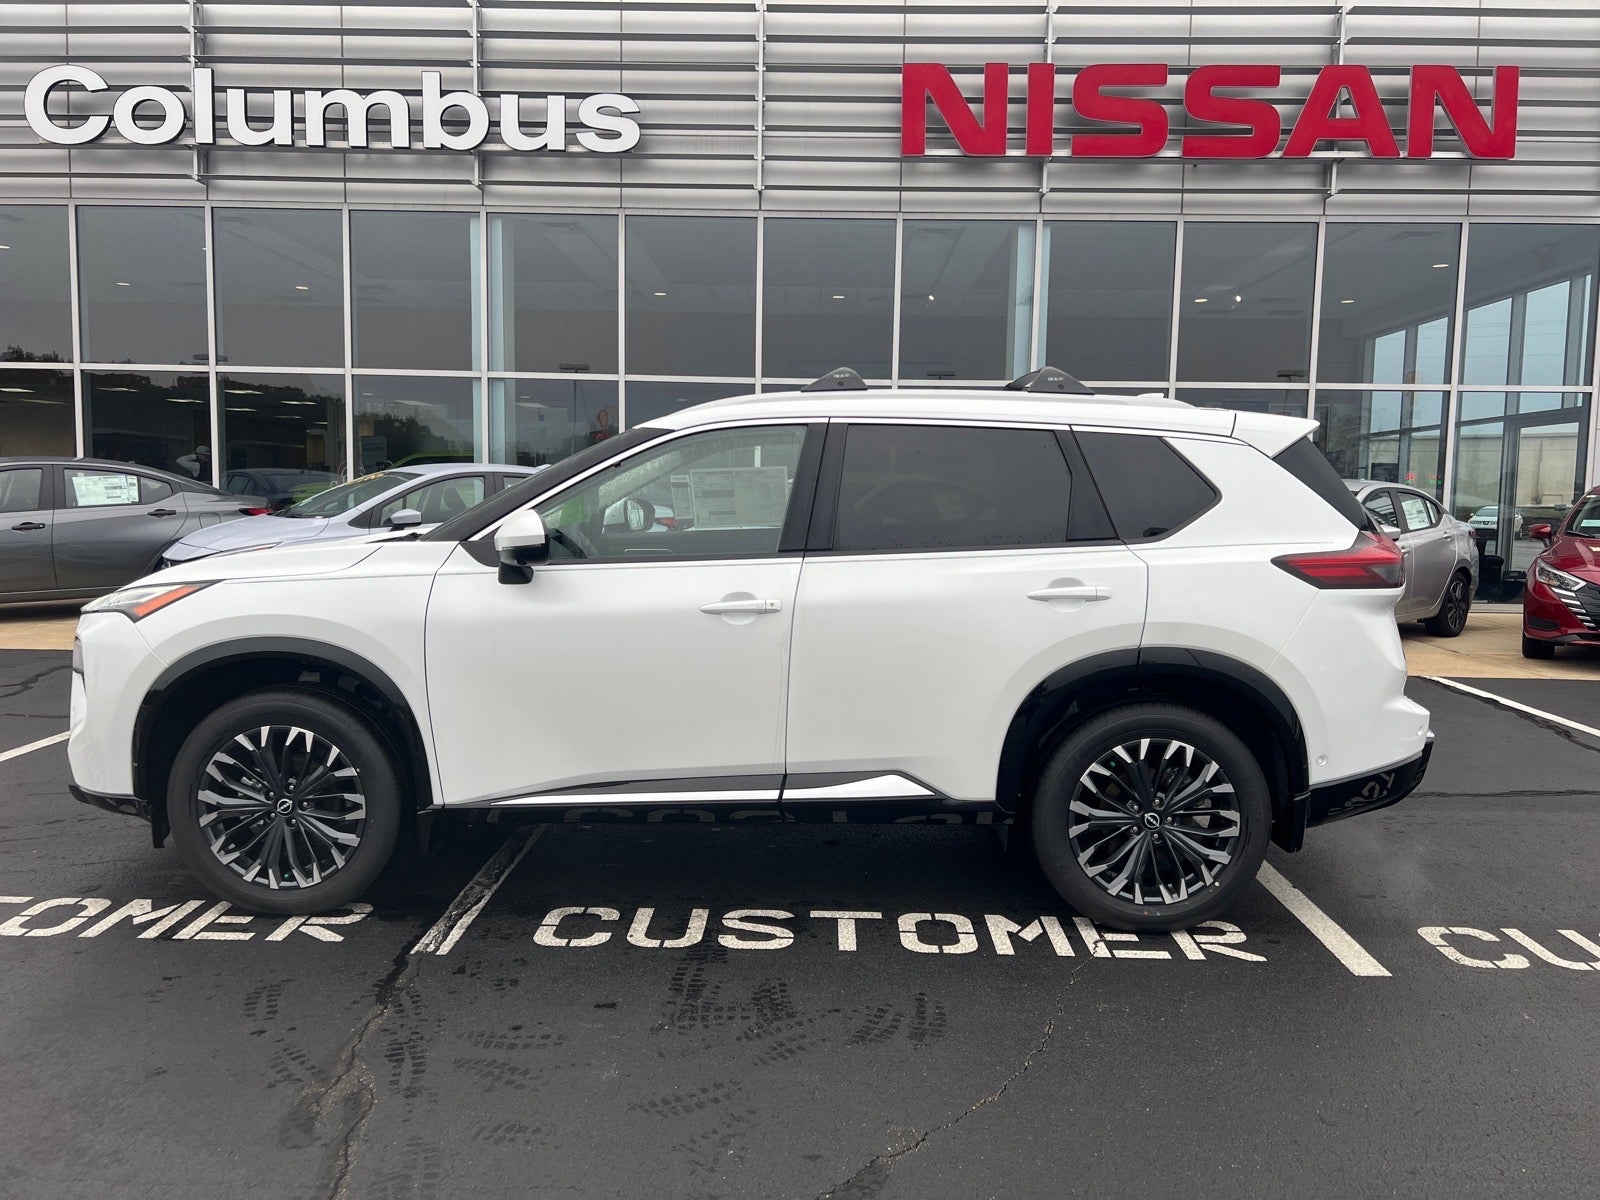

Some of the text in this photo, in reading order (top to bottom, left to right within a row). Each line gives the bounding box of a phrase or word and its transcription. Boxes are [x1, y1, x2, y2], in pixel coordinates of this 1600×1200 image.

[24, 64, 641, 153] Columbus
[901, 63, 1520, 159] NISSAN
[533, 906, 1268, 962] CUSTOMER
